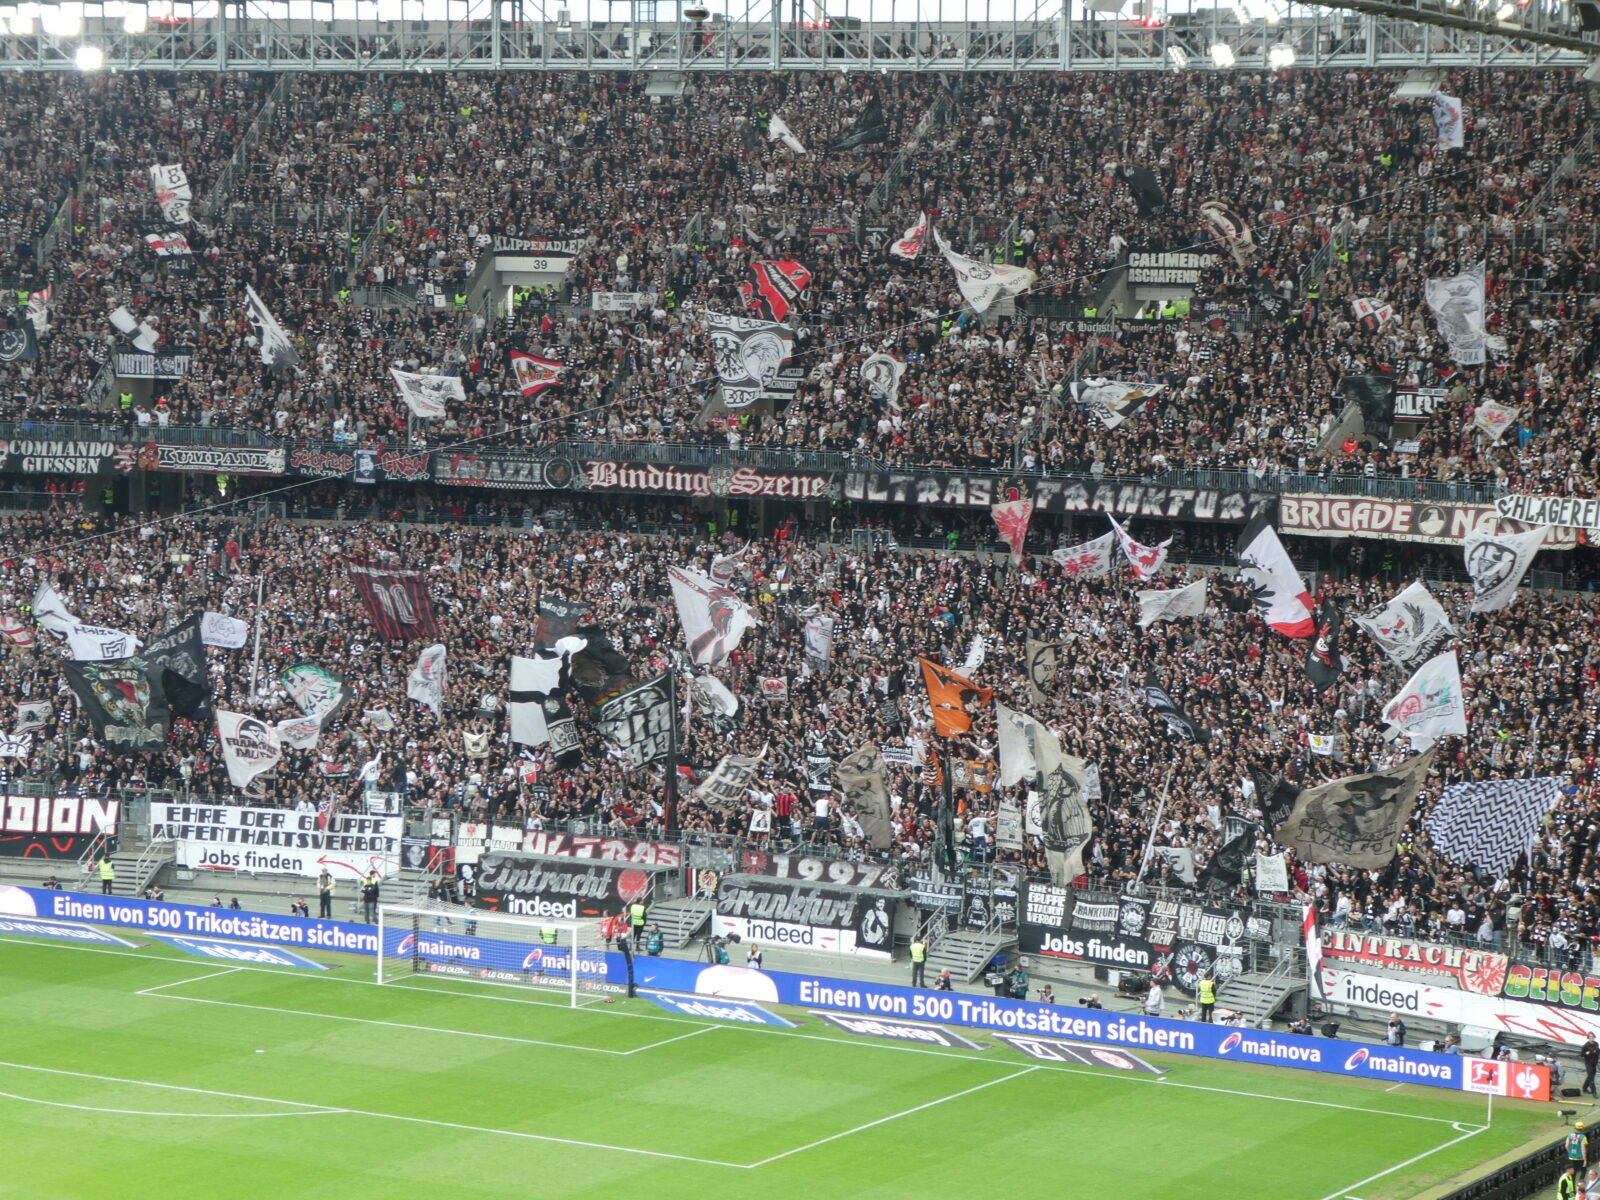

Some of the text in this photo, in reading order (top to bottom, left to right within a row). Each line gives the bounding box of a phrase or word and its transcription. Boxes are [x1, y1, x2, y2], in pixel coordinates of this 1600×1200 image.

[533, 259, 548, 270] 39
[1128, 268, 1202, 283] ASCHAFFENB
[118, 353, 155, 374] MOTOR
[9, 440, 114, 457] COMMANDO
[22, 457, 101, 474] GIESSEN
[585, 460, 826, 497] Binding Szene
[844, 472, 1278, 520] ULTRAS FRANKFURT
[1281, 499, 1414, 532] BRIGADE
[372, 582, 419, 624] 10
[1407, 627, 1449, 668] FRANKF
[0, 795, 120, 836] DION
[166, 806, 227, 825] EHRE
[240, 810, 285, 829] DER
[152, 823, 398, 852] AUFENTHALTSVERBOT
[521, 831, 682, 868] ULTRAS
[198, 849, 303, 871] Jobs finden
[772, 853, 885, 888] 1997
[477, 857, 613, 900] Eintracht
[915, 870, 961, 884] ULAS
[508, 894, 577, 919] indeed
[716, 878, 858, 927] Frankfurt
[1028, 891, 1066, 907] GRUPPE
[1151, 900, 1179, 916] FULDA
[53, 895, 378, 951] Einen von 500 Trikotsätzen sichern
[1026, 911, 1063, 927] VERBOT
[1075, 904, 1119, 919] RANKFURT
[1151, 917, 1175, 929] 3 6
[746, 918, 814, 945] indeed
[1199, 915, 1227, 935] RIED
[1040, 932, 1149, 965] Jobs finden
[1148, 930, 1175, 945] CREW
[1197, 931, 1225, 945] GEBIET
[418, 940, 481, 960] mainova
[1320, 929, 1485, 972] EINTRACHT
[542, 953, 608, 975] mainova
[1359, 956, 1384, 970] ewig
[1408, 965, 1452, 977] ergeben
[1346, 978, 1419, 1011] indeed
[799, 981, 1194, 1050] Einen von 500 Trikotsätzen sichern
[1241, 1039, 1321, 1063] mainova
[1368, 1056, 1452, 1081] mainova
